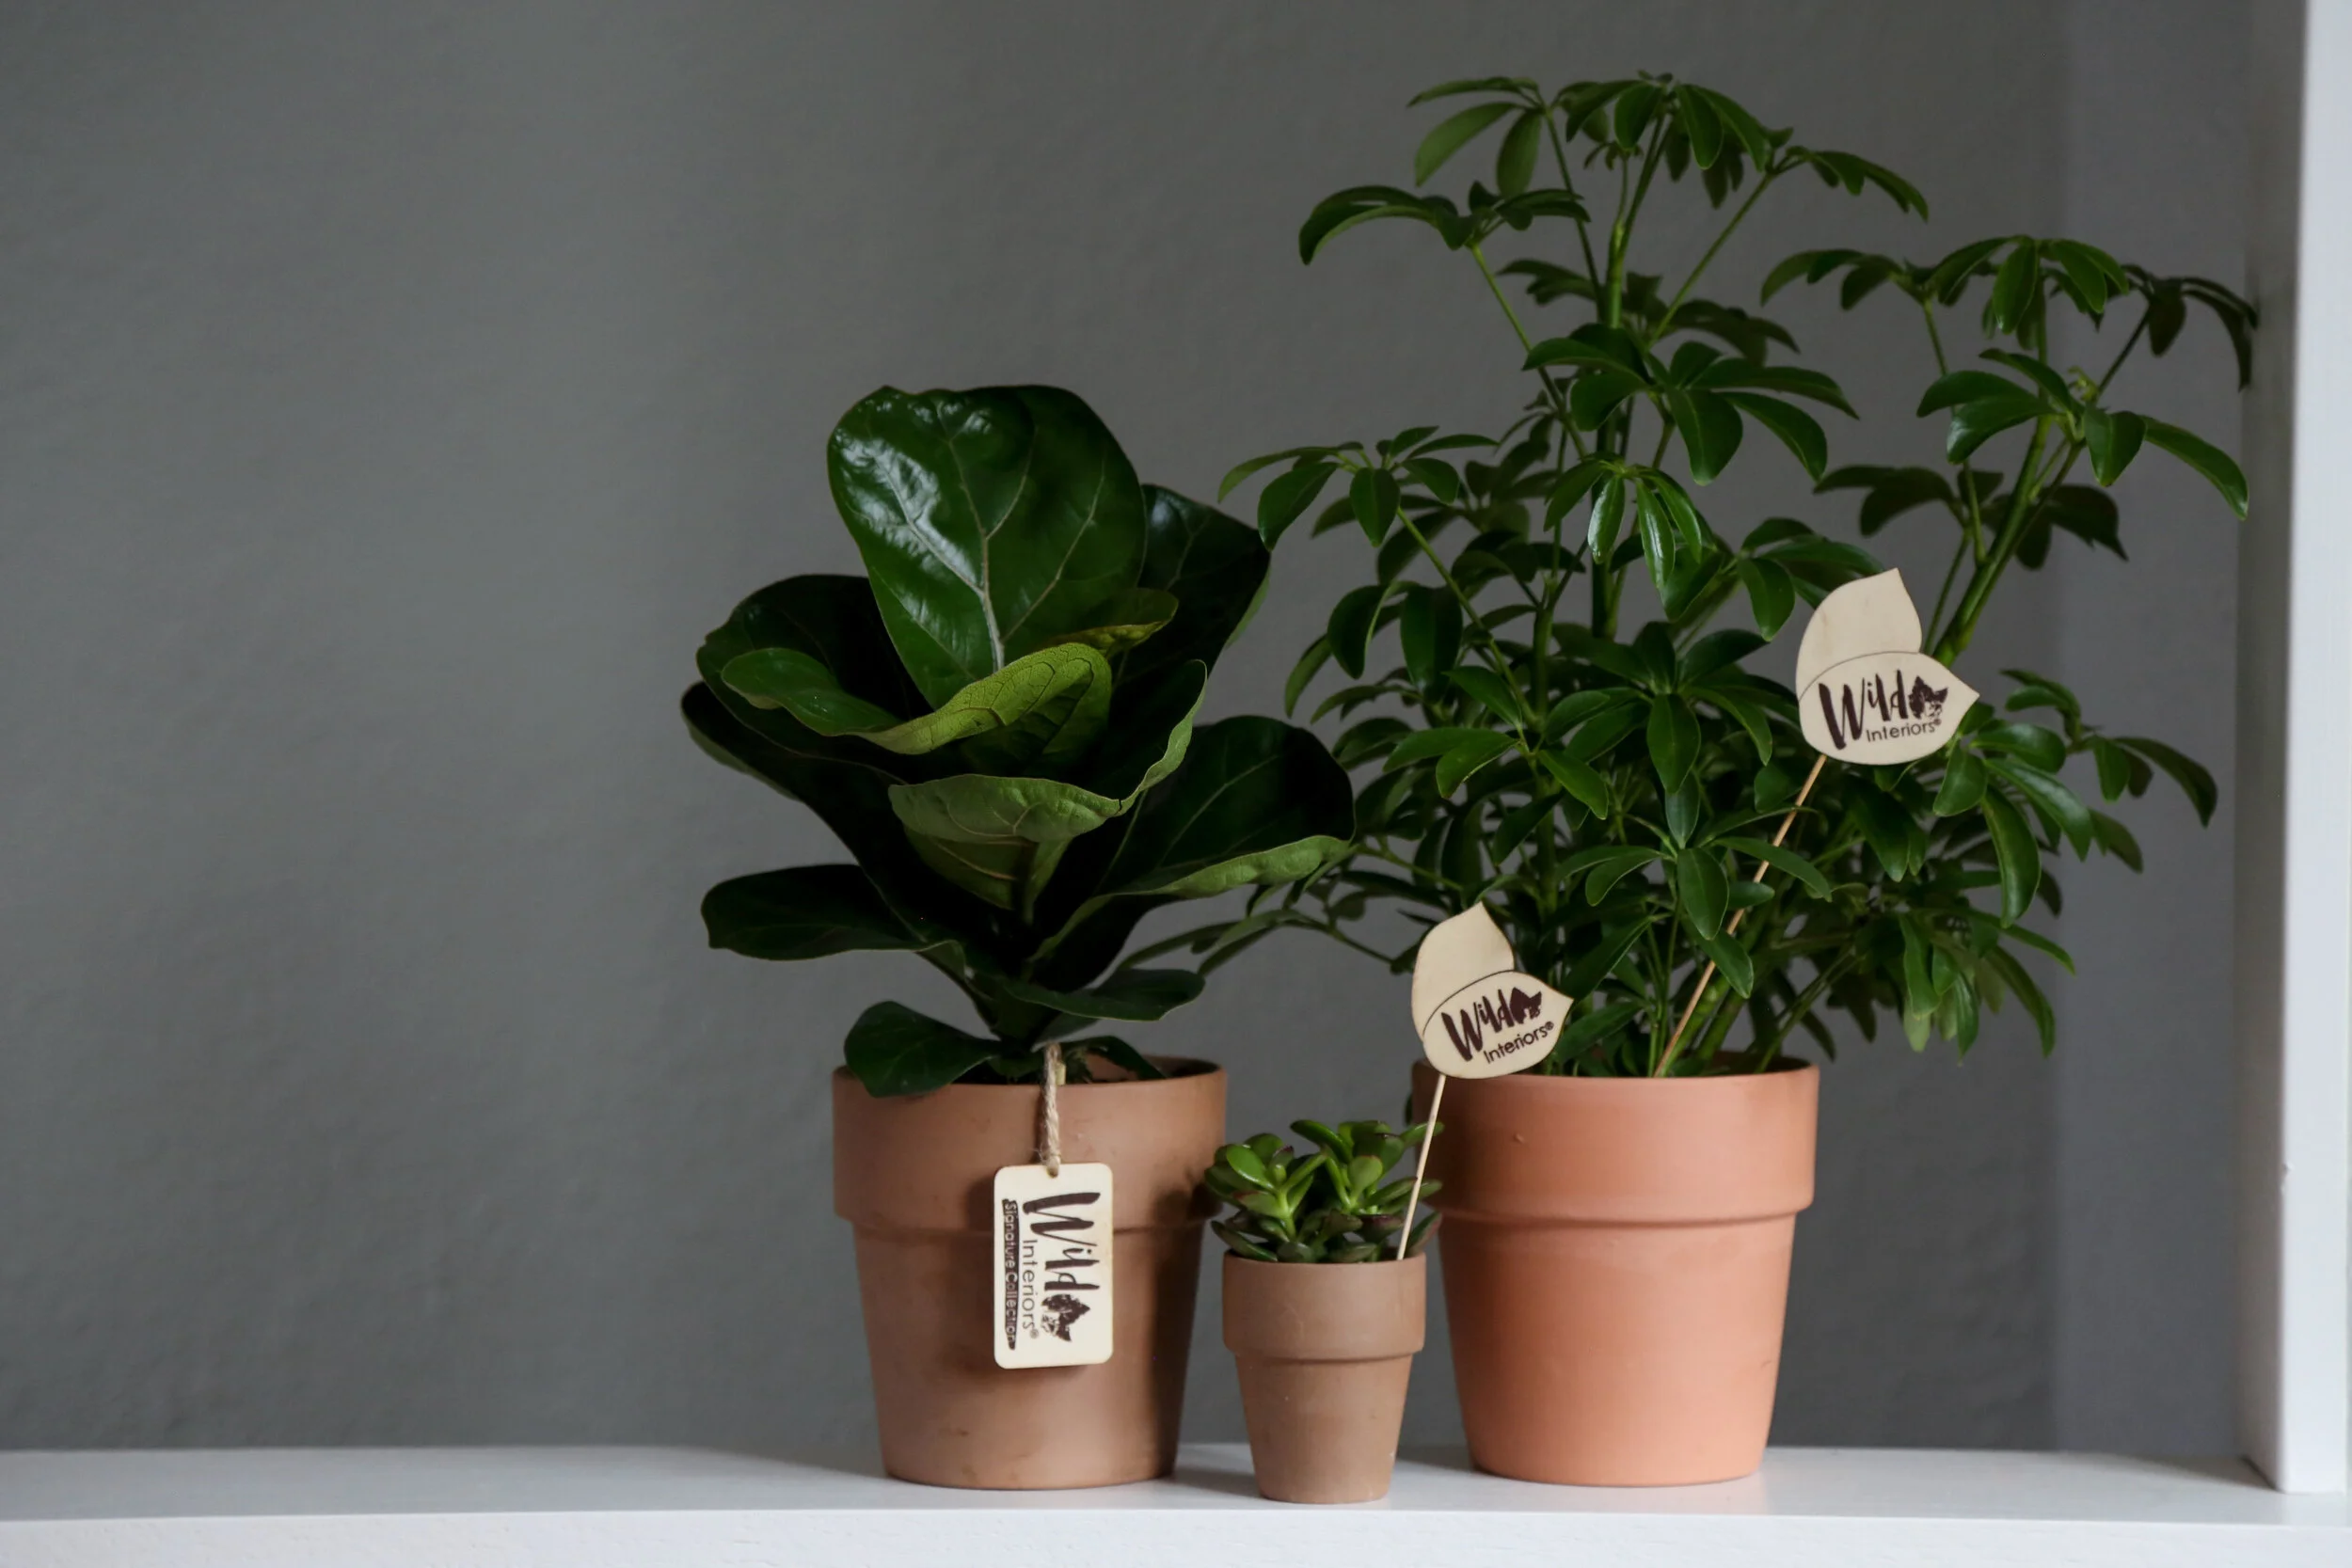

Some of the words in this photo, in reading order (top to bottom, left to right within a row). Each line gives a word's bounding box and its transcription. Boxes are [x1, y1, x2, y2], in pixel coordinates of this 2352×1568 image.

[1818, 669, 1908, 750] Wild
[1440, 989, 1515, 1062] Wild
[1003, 1203, 1018, 1269] Signature
[1022, 1192, 1101, 1291] Wild
